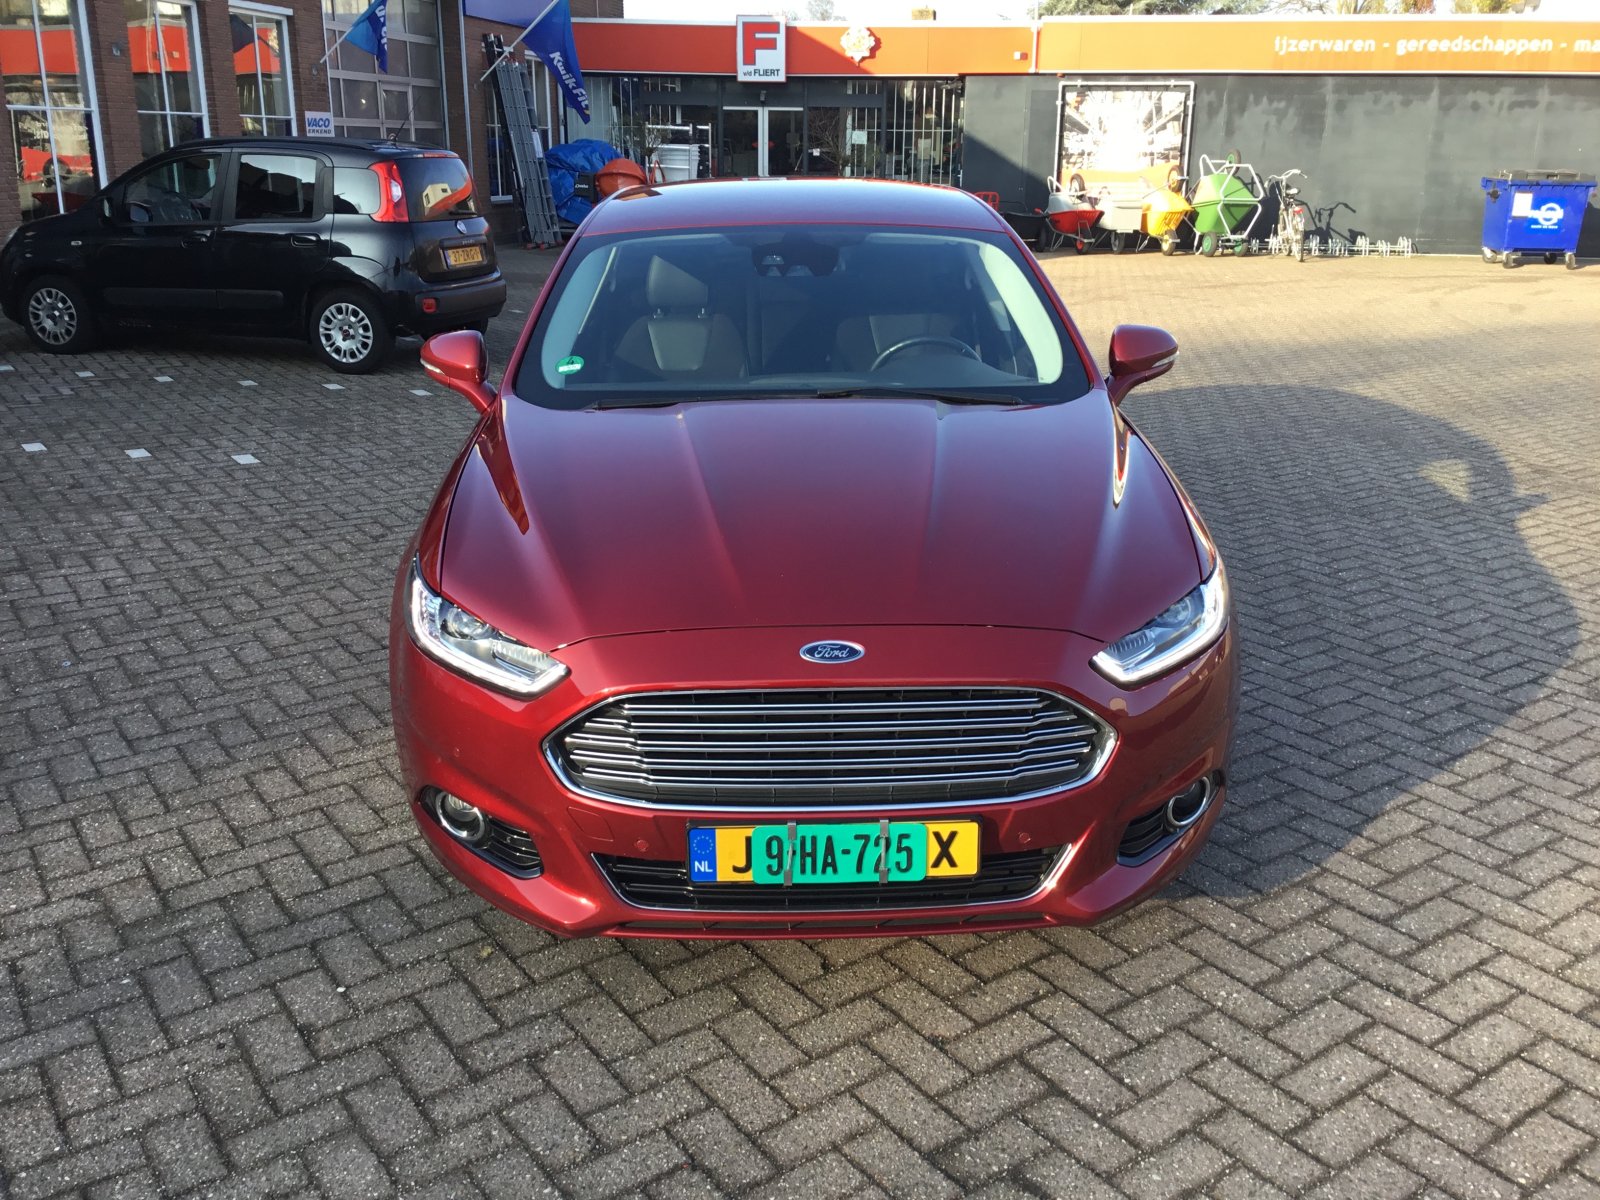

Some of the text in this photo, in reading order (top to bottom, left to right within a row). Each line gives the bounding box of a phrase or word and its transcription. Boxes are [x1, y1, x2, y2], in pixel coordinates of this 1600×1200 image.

[742, 22, 780, 66] F
[1274, 36, 1376, 56] ijzerwaren
[1396, 35, 1553, 56] gereedschappen
[549, 51, 577, 90] Kwik
[753, 68, 780, 77] FLIERT
[307, 117, 330, 128] VACO
[814, 644, 850, 658] Ford
[694, 861, 713, 873] NL
